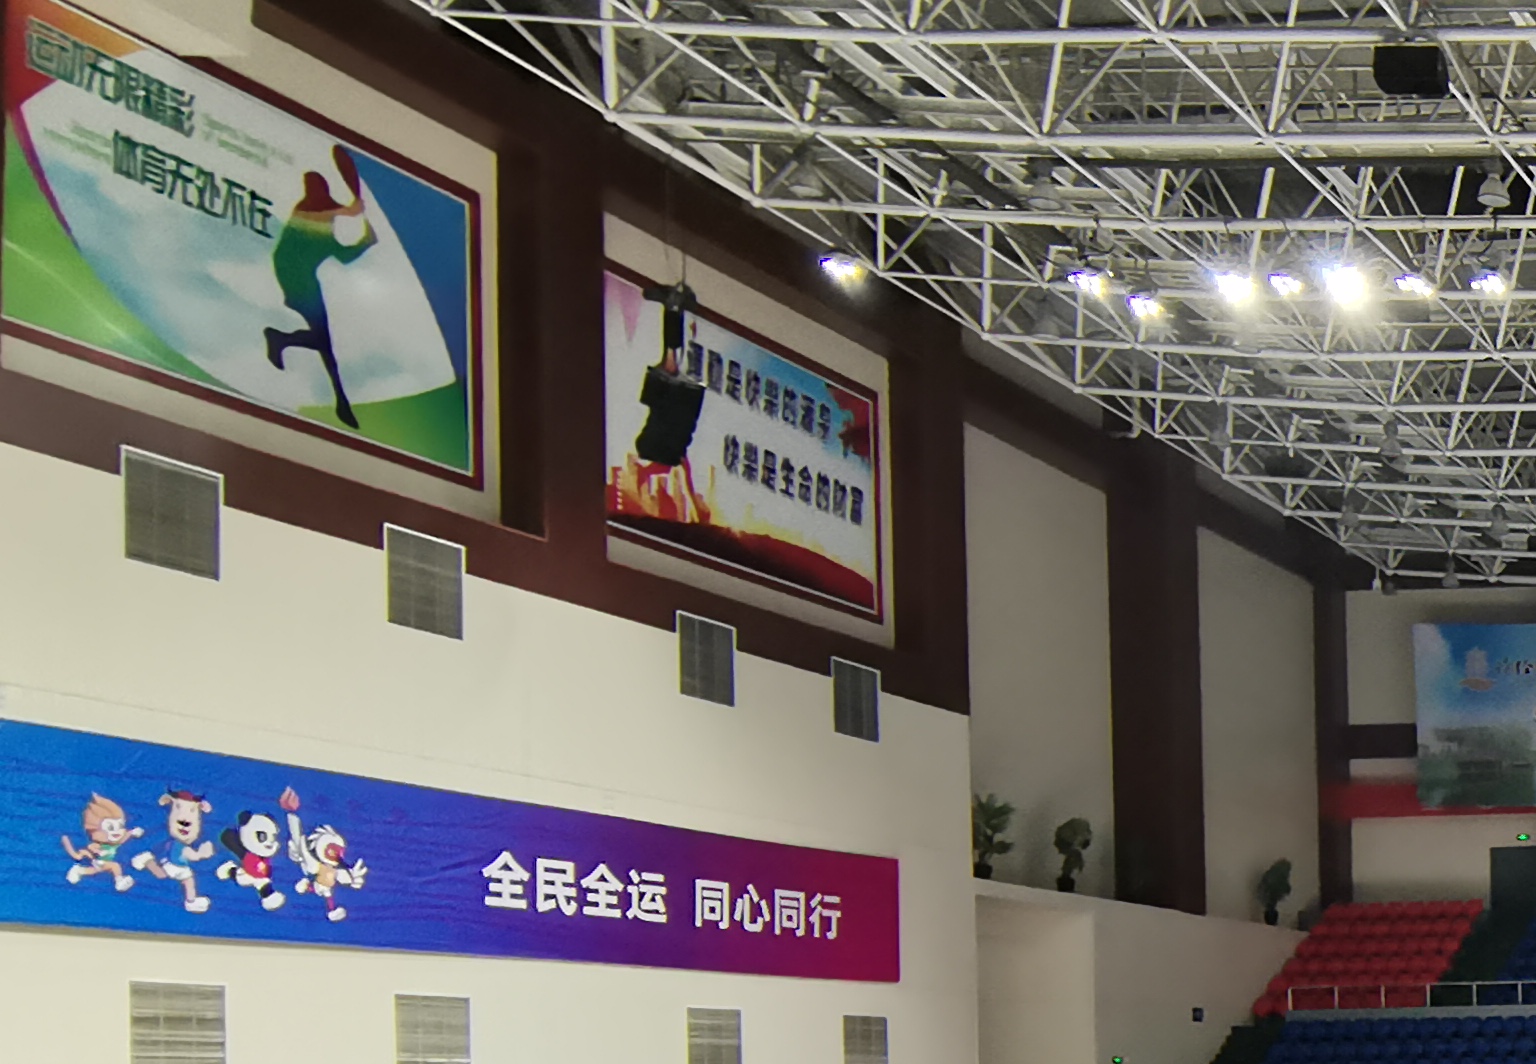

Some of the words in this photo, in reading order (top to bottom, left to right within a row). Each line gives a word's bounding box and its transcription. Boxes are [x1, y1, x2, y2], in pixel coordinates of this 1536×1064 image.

[25, 15, 195, 138] 运动无限精彩
[113, 129, 274, 239] 体育无处不在
[481, 850, 668, 924] 全民全运
[694, 877, 842, 940] 同心同行
